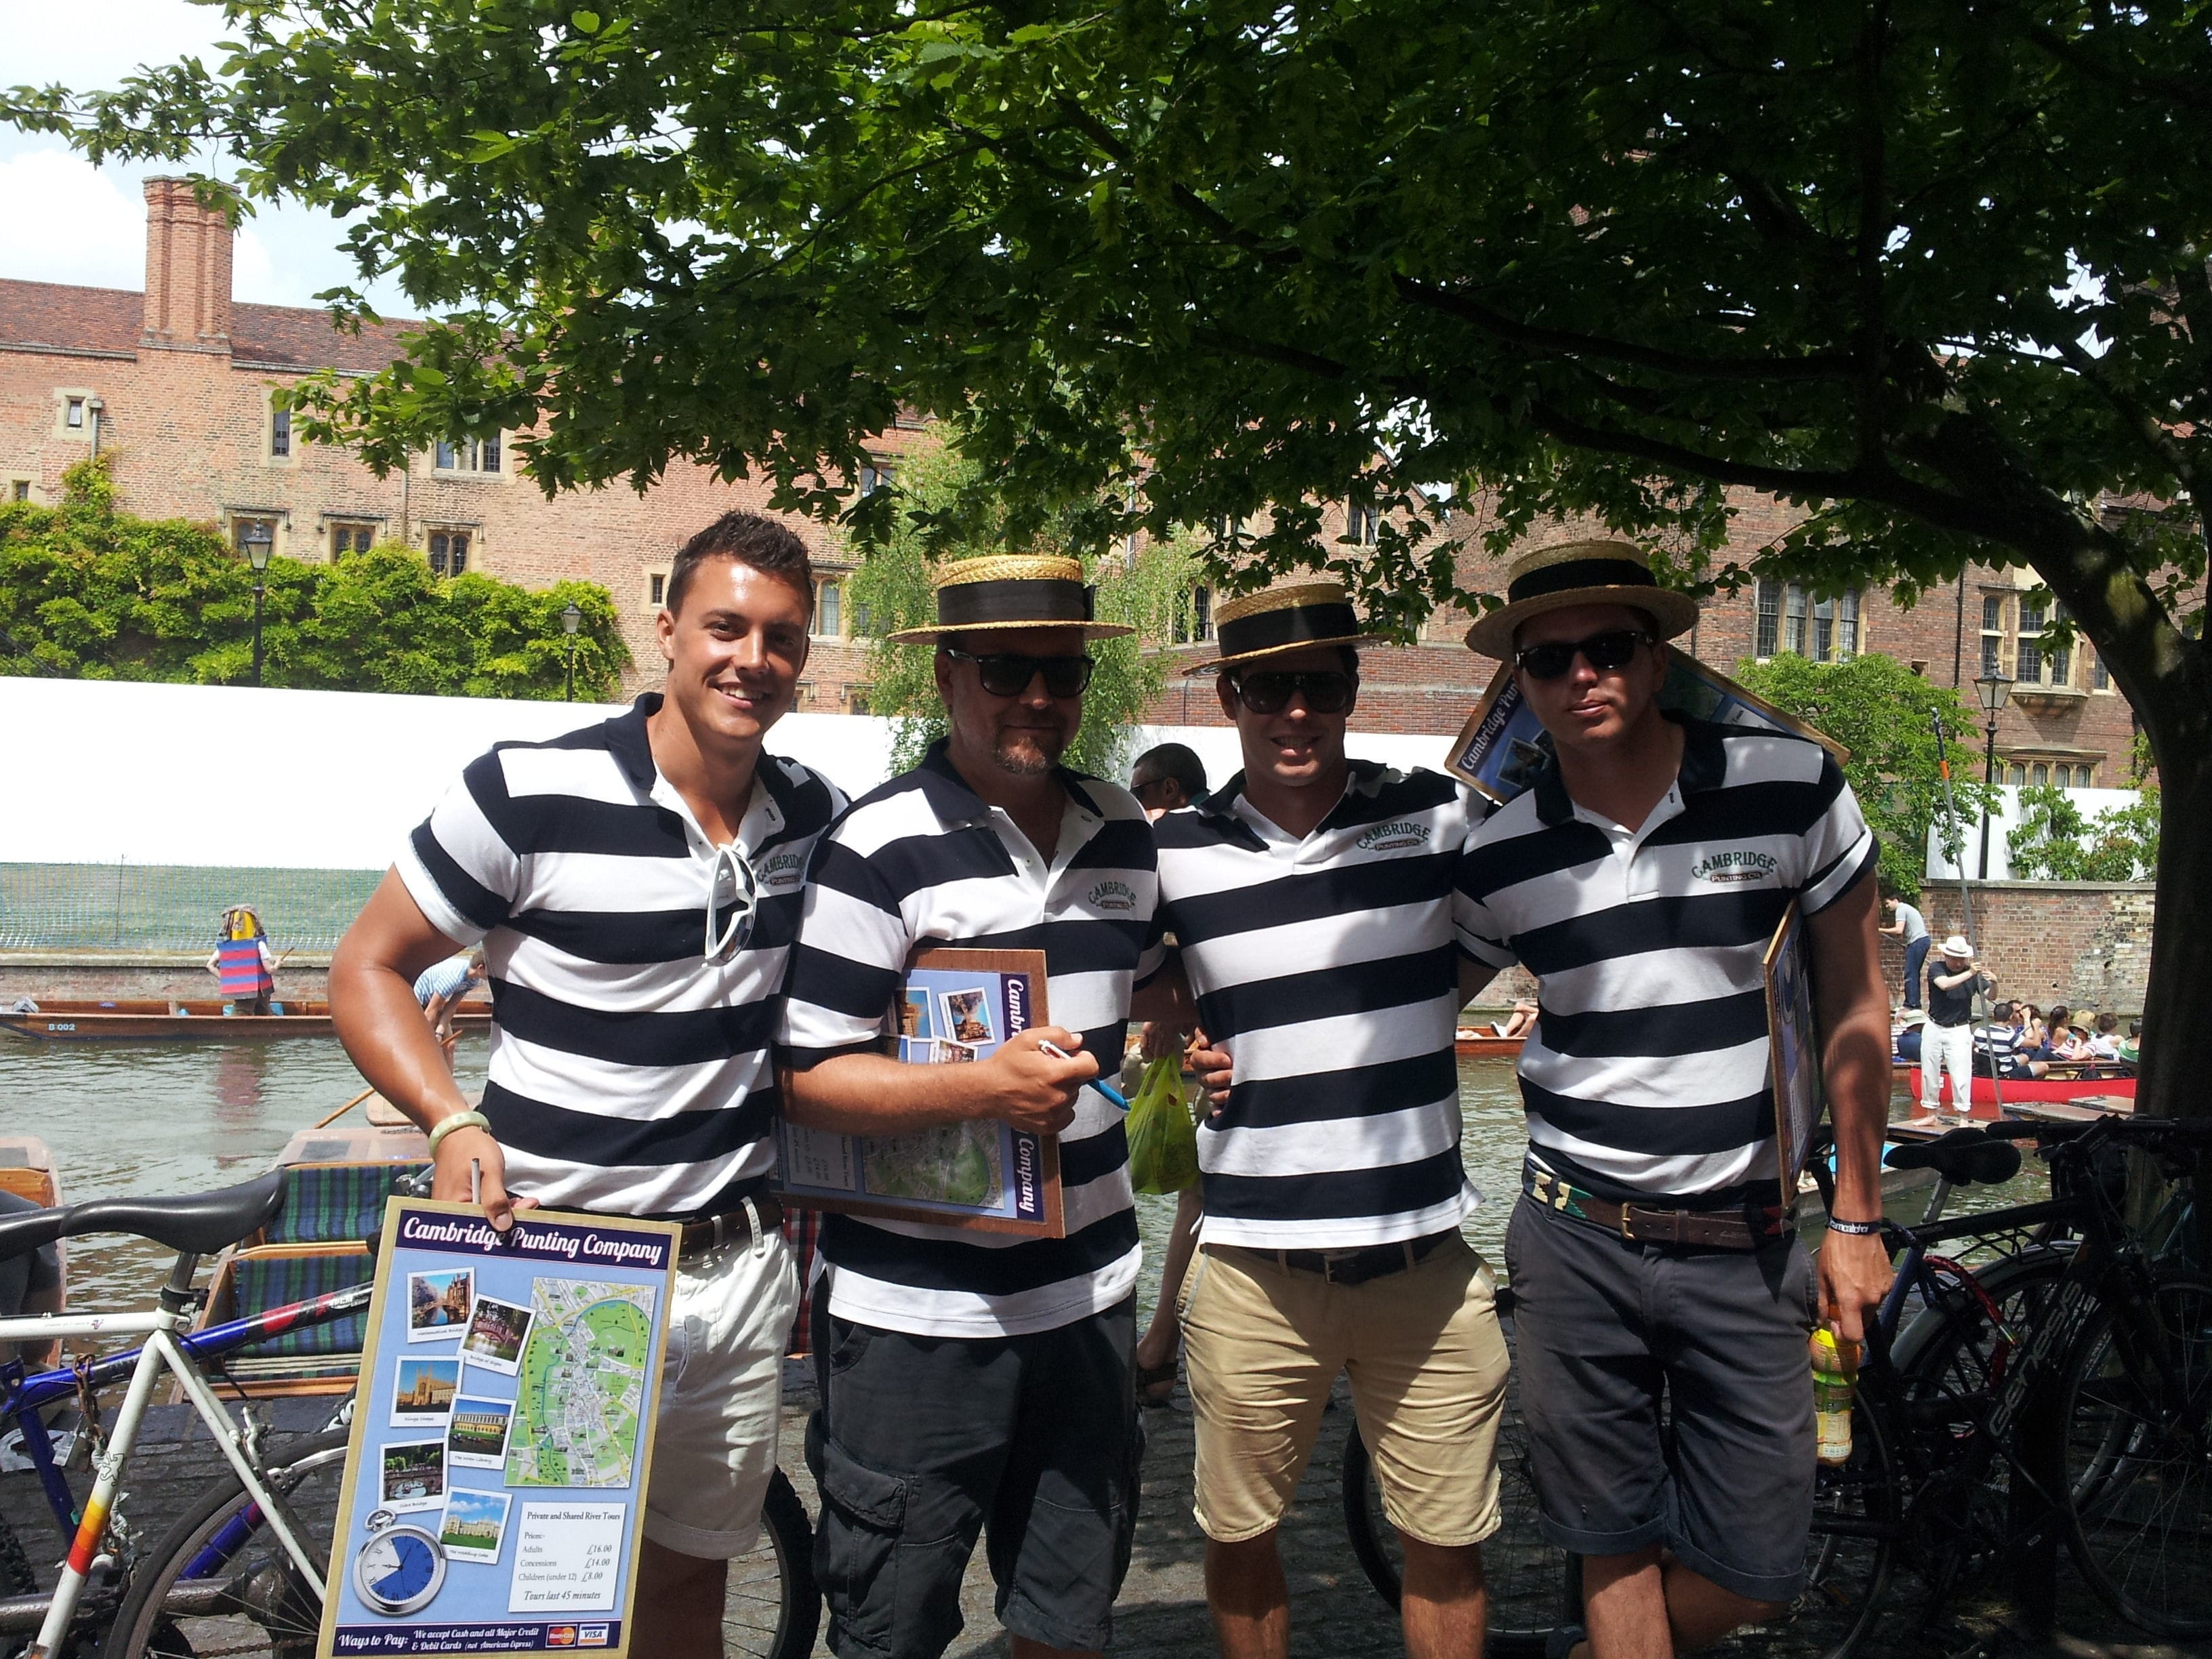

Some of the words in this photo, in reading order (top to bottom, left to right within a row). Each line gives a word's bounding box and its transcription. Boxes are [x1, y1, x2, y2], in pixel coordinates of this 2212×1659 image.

[1461, 707, 1506, 770] Cambridge
[1357, 822, 1431, 849] CAMBRIDGE
[1692, 852, 1777, 878] CAMBRIDGE
[1017, 1139, 1035, 1213] Company
[403, 1217, 505, 1252] Cambridge
[511, 1227, 581, 1259] Punting
[583, 1233, 663, 1266] Company
[585, 1512, 601, 1520] River
[602, 1512, 620, 1520] Tours
[586, 1544, 612, 1555] £16.00
[584, 1558, 610, 1569] £14.00
[546, 1574, 567, 1582] (under
[568, 1573, 577, 1581] 12)
[581, 1572, 603, 1582] £8.00
[524, 1591, 544, 1601] Tours
[546, 1591, 560, 1600] last
[561, 1591, 571, 1599] 45
[572, 1591, 600, 1599] minutes
[413, 1629, 426, 1639] We
[427, 1630, 450, 1640] accept
[451, 1629, 468, 1638] Cash
[469, 1629, 483, 1638] and
[485, 1628, 494, 1637] all
[496, 1628, 517, 1639] Major
[518, 1627, 539, 1636] Credit
[338, 1634, 369, 1650] Ways
[371, 1635, 382, 1646] to
[411, 1641, 419, 1650] &
[419, 1641, 439, 1650] Debit
[441, 1641, 462, 1650] Cards
[464, 1641, 478, 1650] (not
[480, 1641, 509, 1649] American
[510, 1639, 534, 1649] Express)
